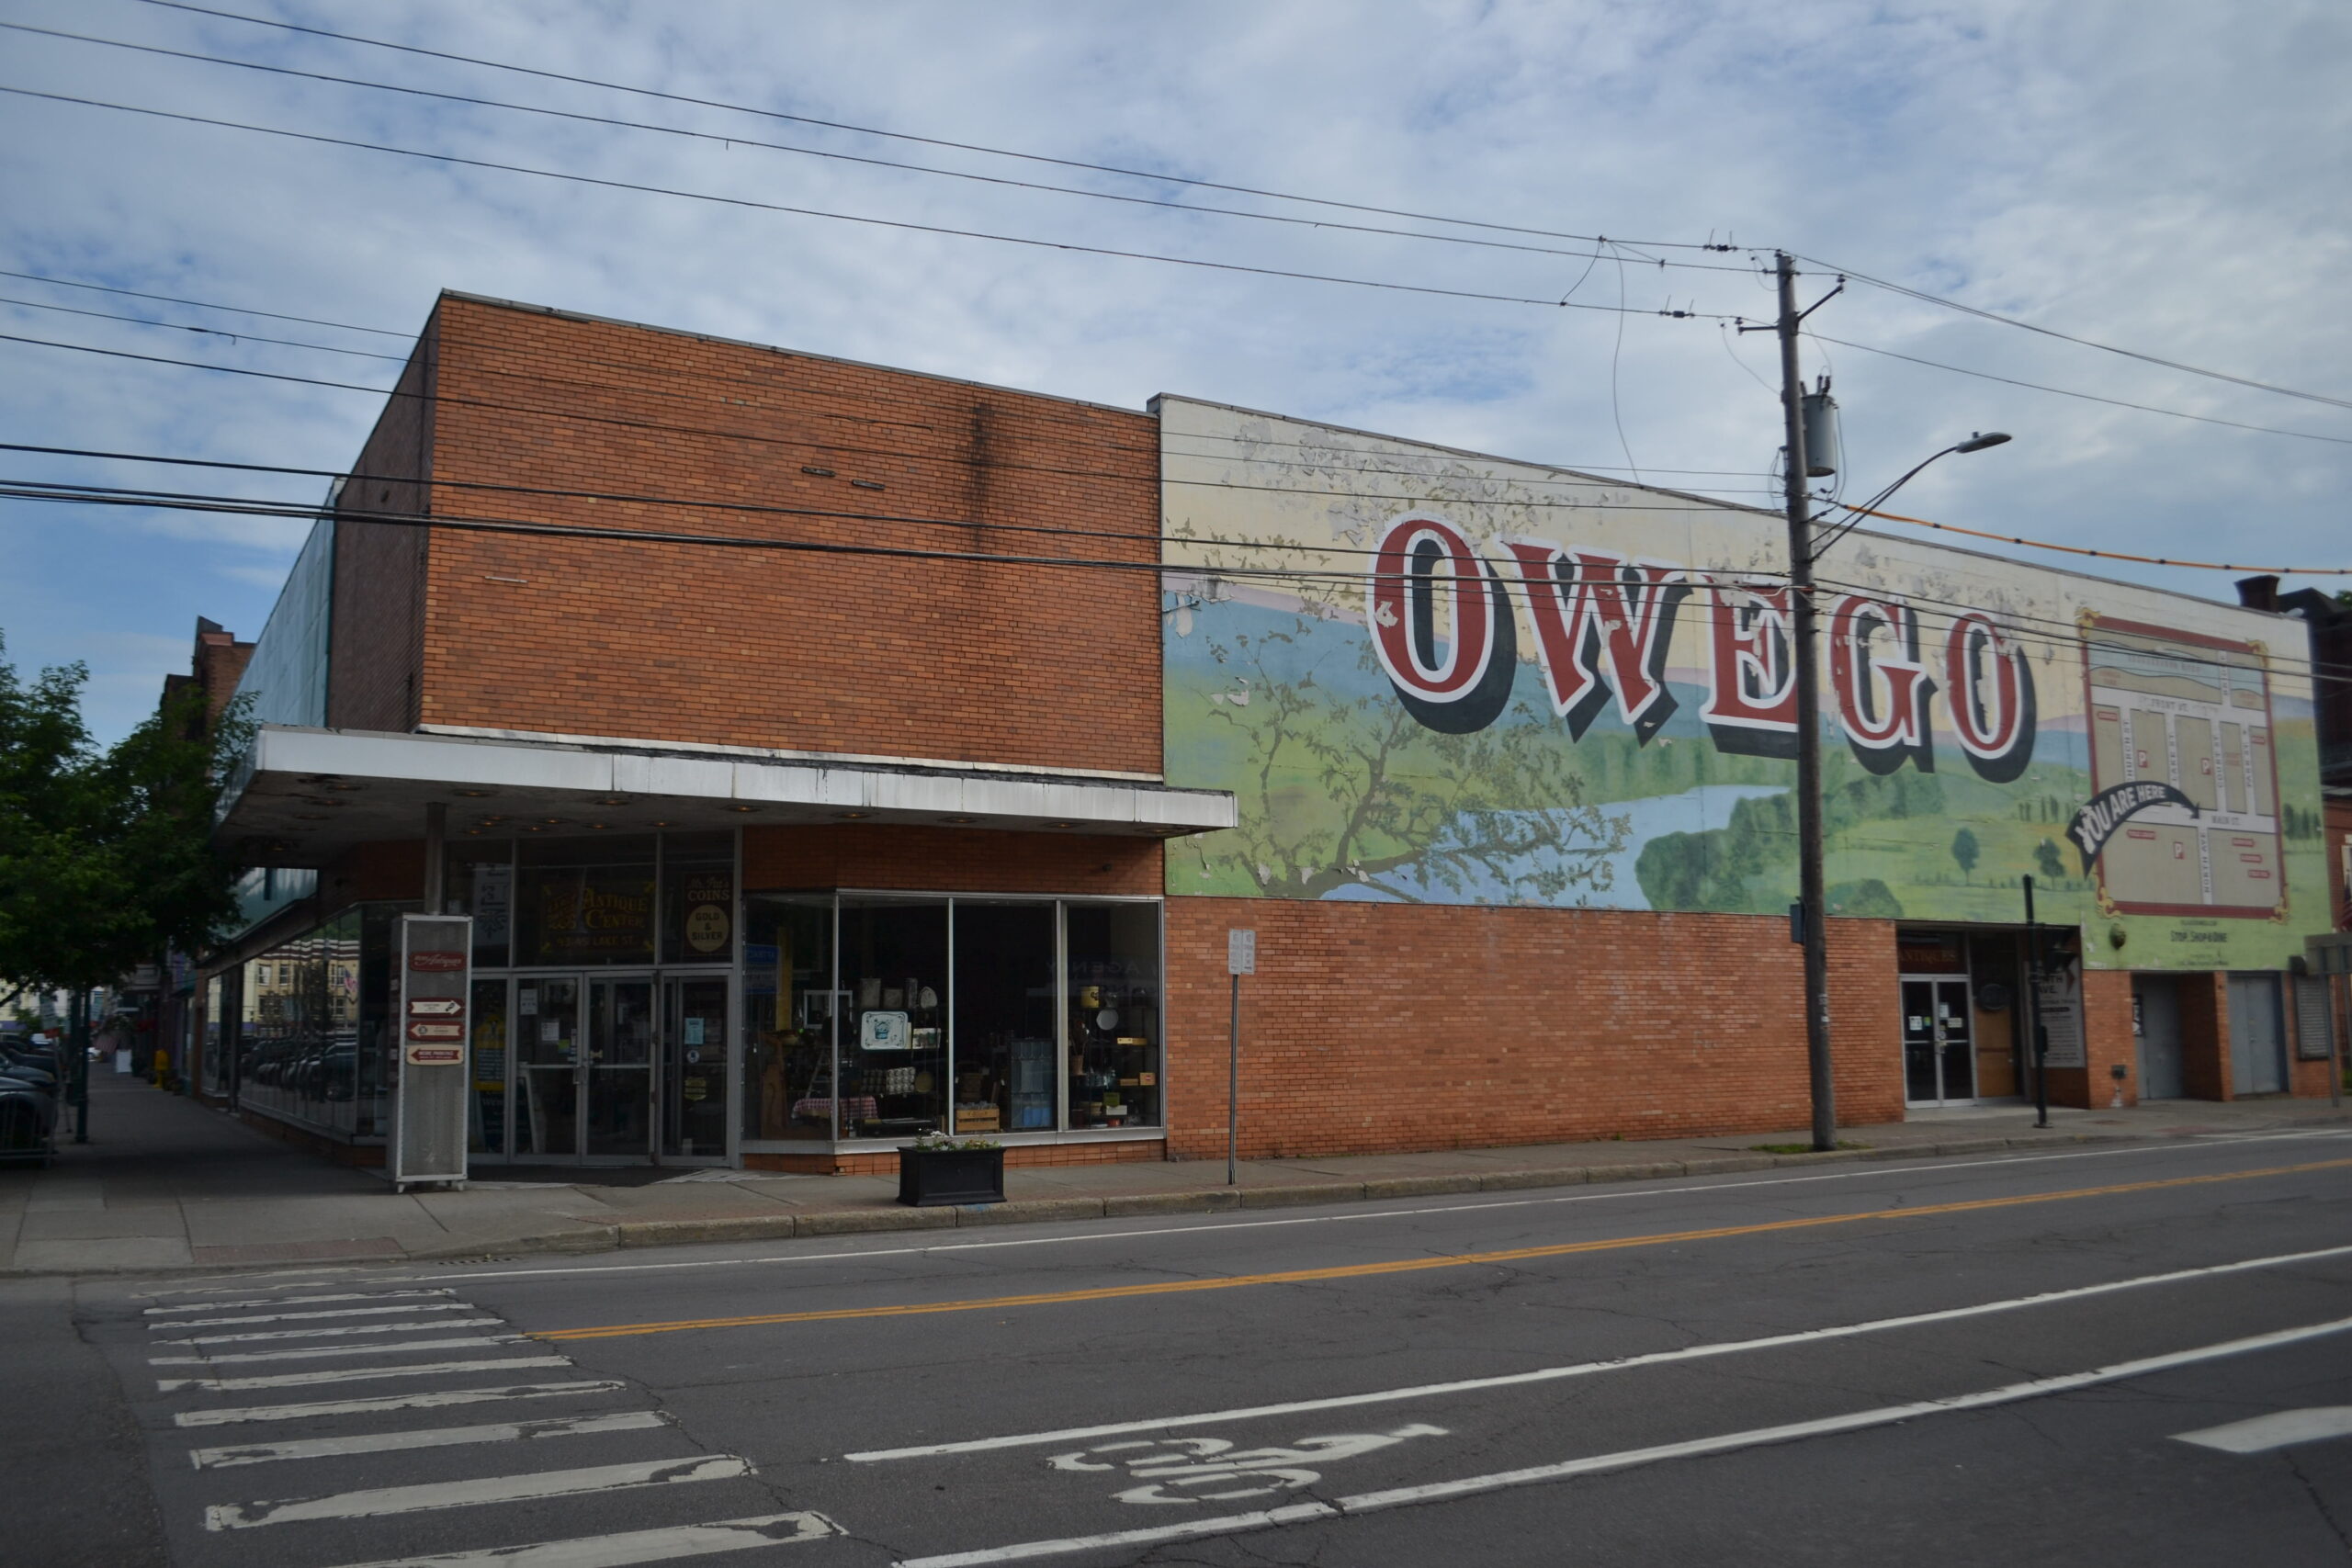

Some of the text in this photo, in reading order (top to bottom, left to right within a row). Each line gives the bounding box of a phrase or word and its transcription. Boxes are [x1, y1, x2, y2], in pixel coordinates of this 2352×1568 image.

[1368, 511, 2034, 781] OWEGO
[2075, 784, 2165, 854] YOU ARE HERE
[2201, 856, 2211, 893] NORTH
[583, 887, 649, 912] ANTIQUE
[686, 889, 731, 902] COINS
[585, 909, 647, 929] CENTER
[695, 911, 720, 921] GOLD
[705, 921, 712, 931] &
[691, 931, 723, 942] SILVER
